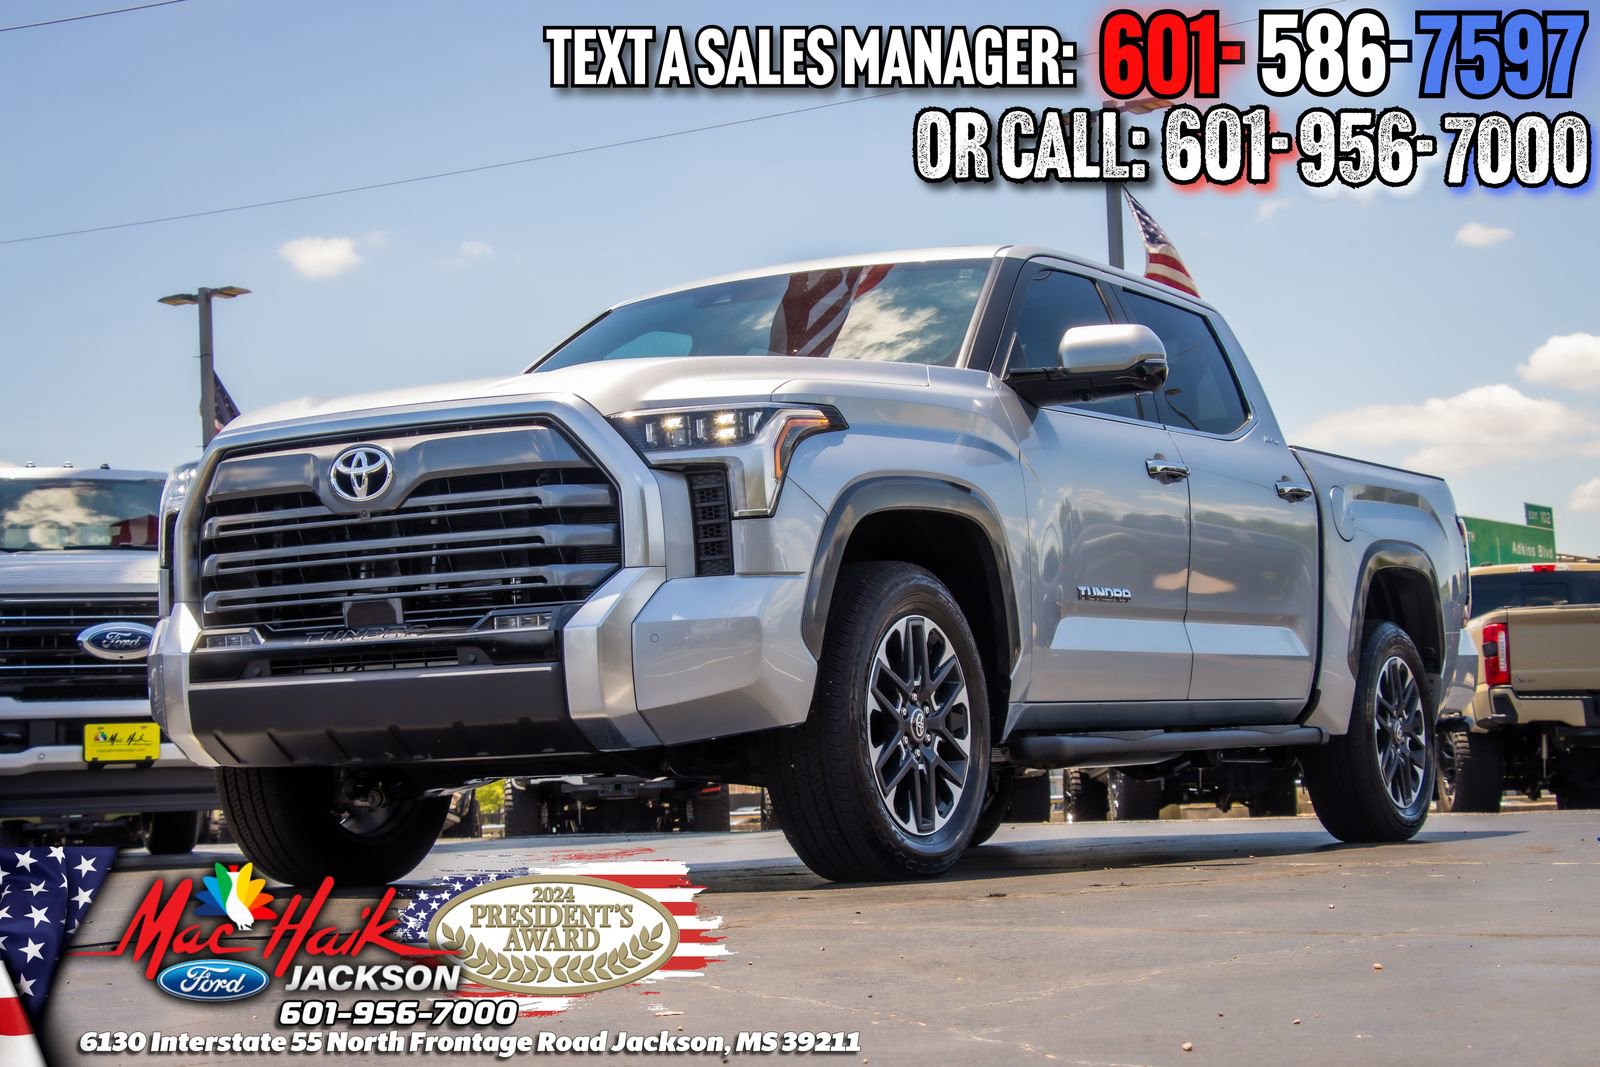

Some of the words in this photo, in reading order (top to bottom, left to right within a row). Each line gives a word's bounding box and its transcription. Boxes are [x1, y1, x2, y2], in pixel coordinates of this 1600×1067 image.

[1540, 511, 1551, 525] 102
[1512, 541, 1536, 557] Adkins
[1538, 544, 1554, 560] Blvd
[1076, 586, 1131, 601] TUNDRA
[102, 632, 141, 648] Ford
